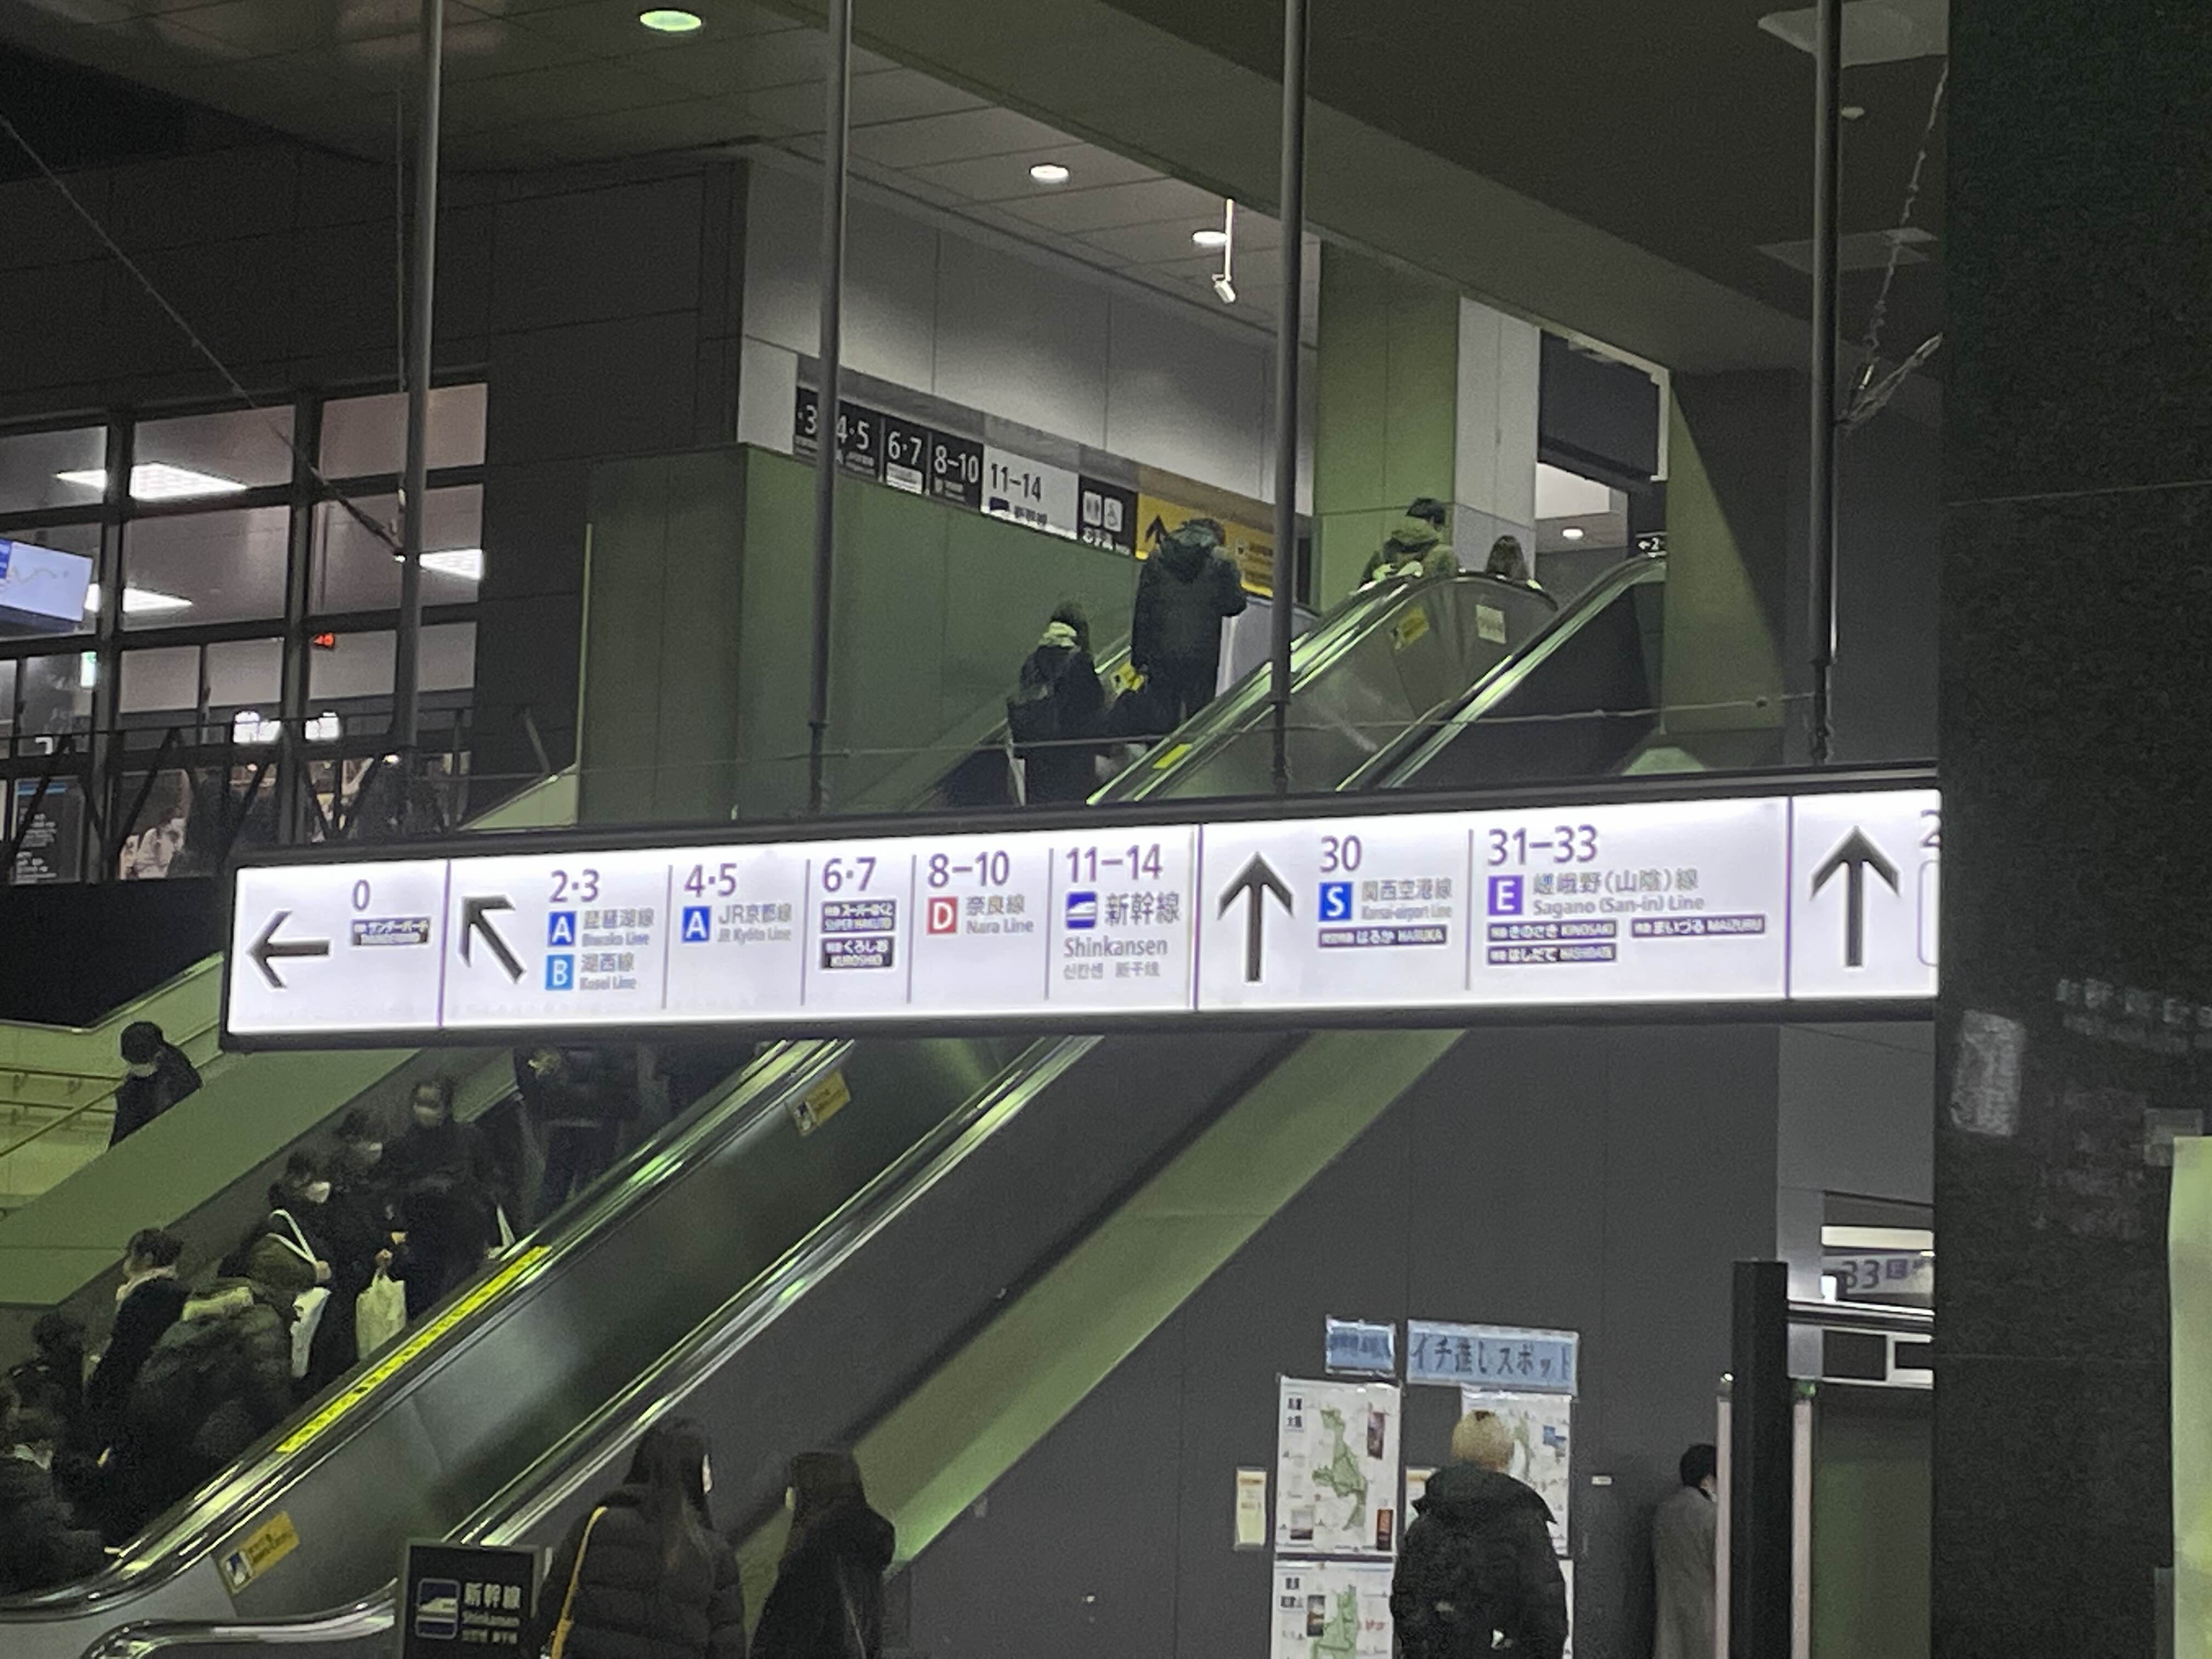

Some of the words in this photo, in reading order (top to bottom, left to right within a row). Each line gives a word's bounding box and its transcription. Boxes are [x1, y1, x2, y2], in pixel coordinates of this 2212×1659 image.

[1319, 835, 1362, 872] 30
[1488, 825, 1598, 866] 31-33
[928, 850, 1010, 888] 8-10
[1066, 843, 1163, 883] 11-14
[352, 879, 370, 912] 0
[966, 894, 1025, 916] 奈良線
[1105, 891, 1180, 927] 新幹線
[1326, 885, 1344, 917] S
[1496, 880, 1516, 911] E
[1533, 900, 1596, 919] Sagano
[1669, 894, 1705, 911] Line
[551, 915, 573, 944] A
[685, 910, 708, 940] A
[933, 901, 954, 930] D
[966, 920, 1000, 934] Nara
[1003, 918, 1034, 933] Line
[1064, 935, 1167, 958] Shinkansen
[552, 958, 569, 987] B
